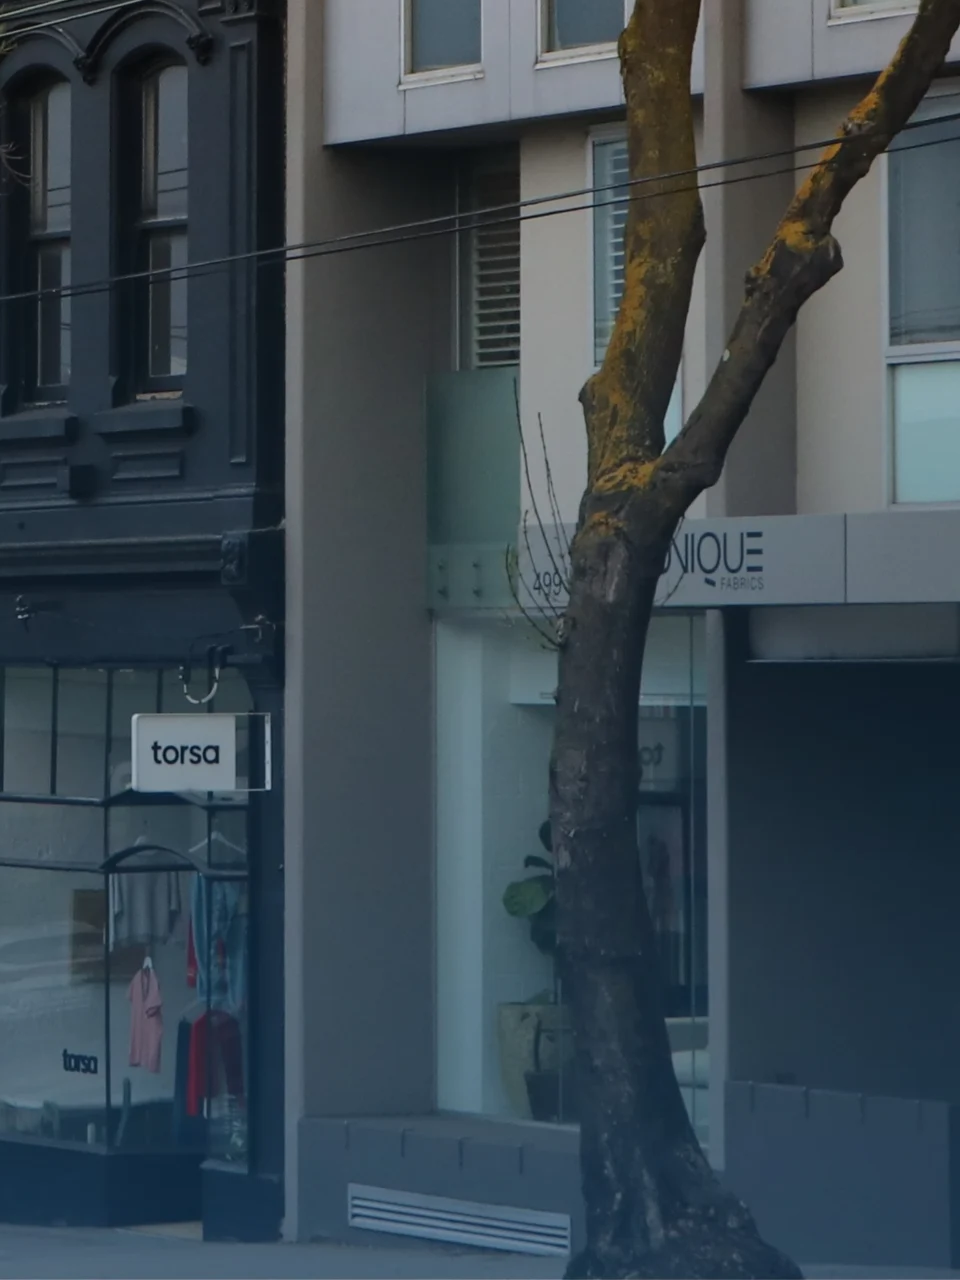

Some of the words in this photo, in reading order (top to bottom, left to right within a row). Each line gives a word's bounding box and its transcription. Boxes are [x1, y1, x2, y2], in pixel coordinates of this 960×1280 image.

[720, 577, 764, 590] FABRICS
[151, 740, 220, 765] torsa
[62, 1048, 98, 1074] torsa
